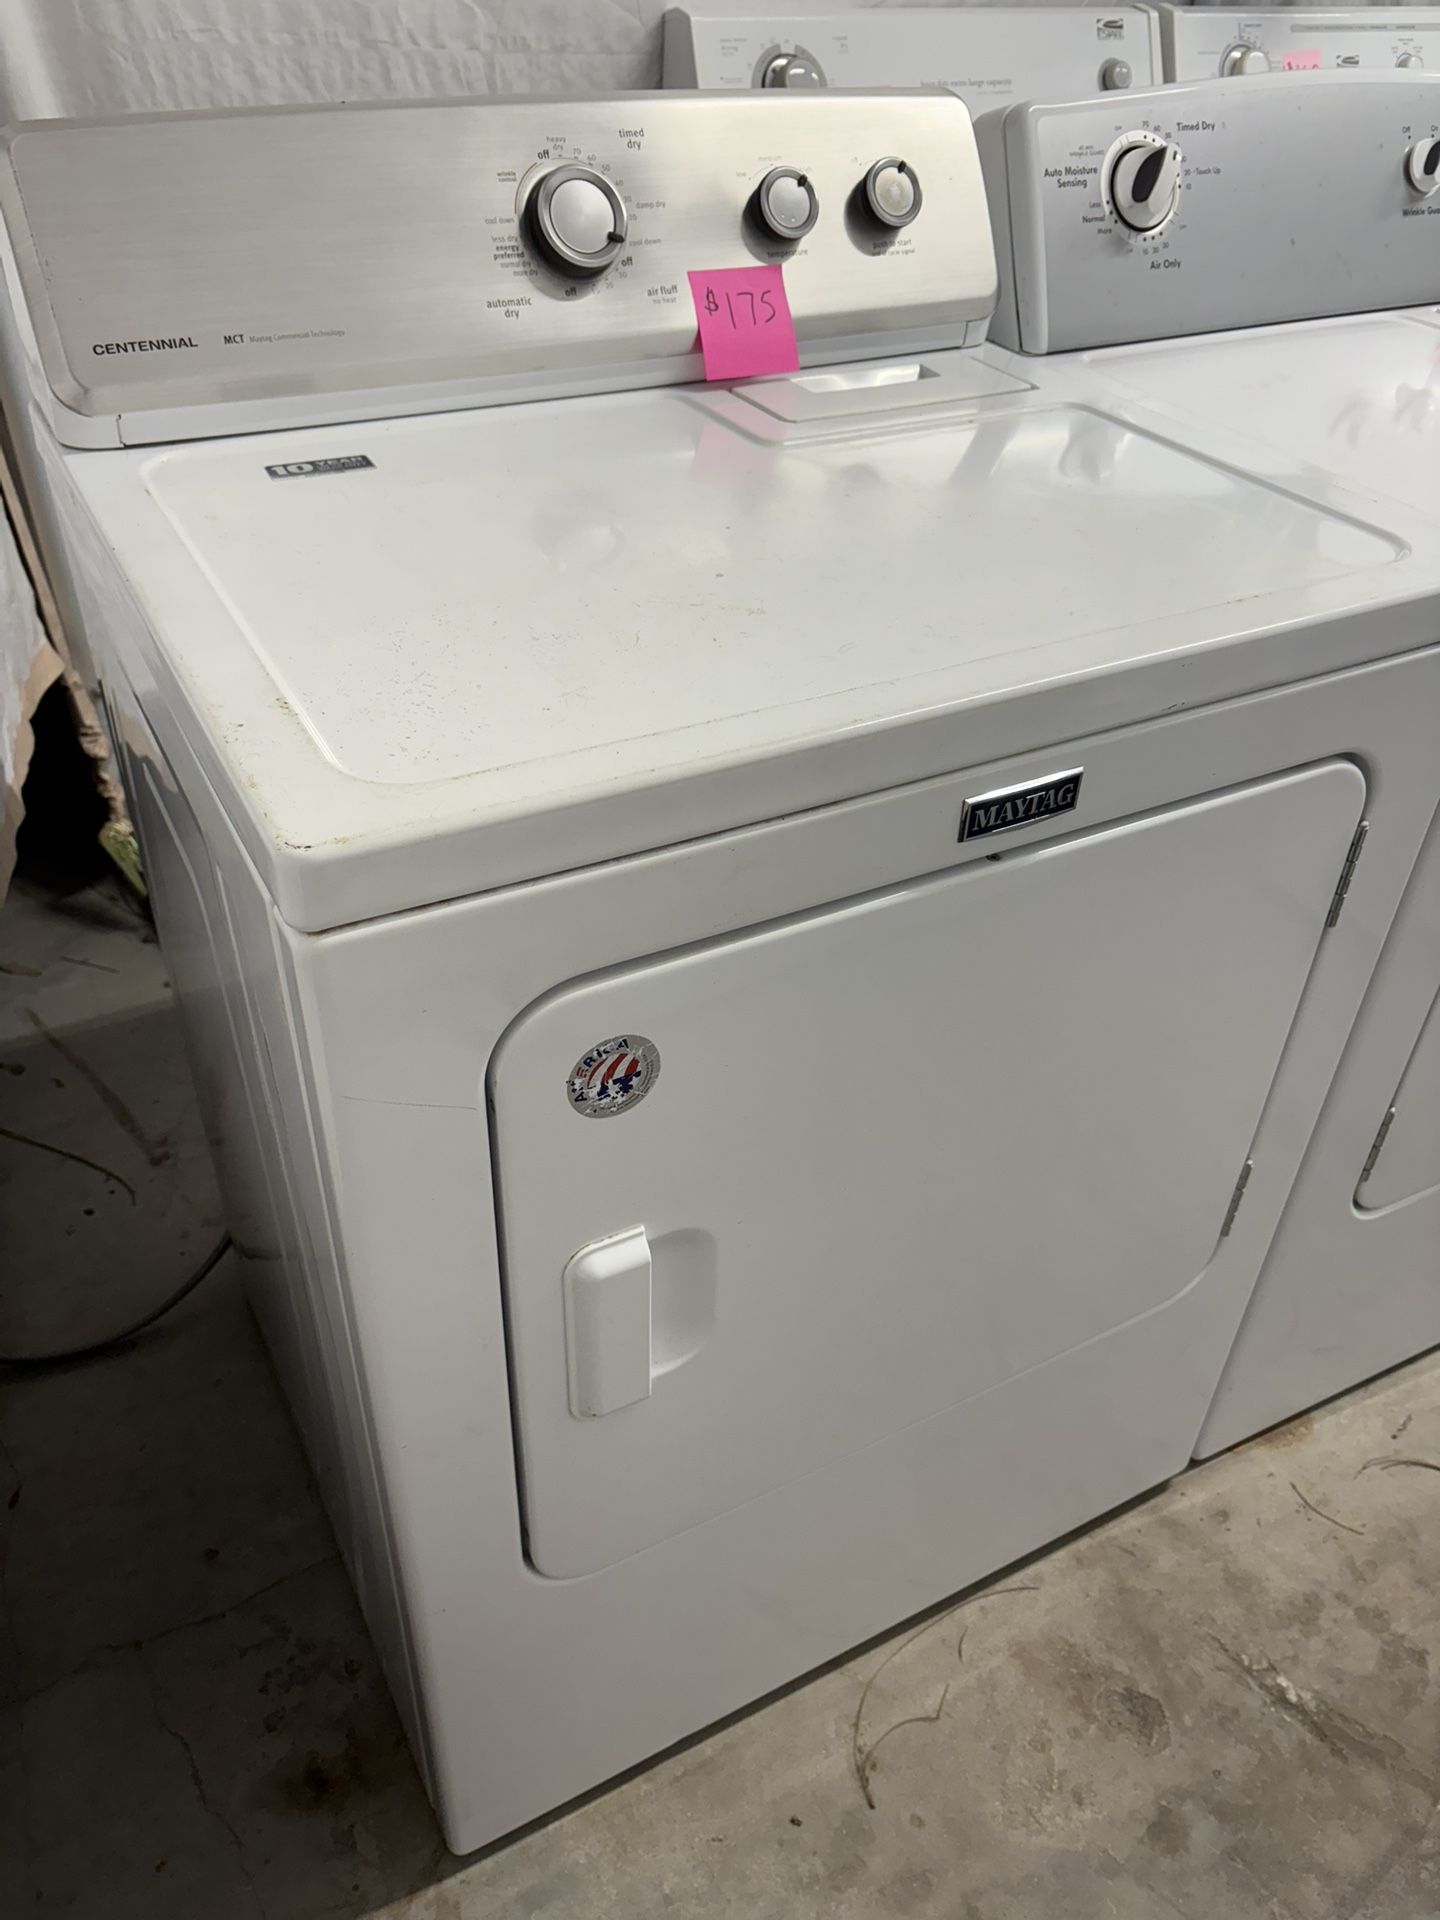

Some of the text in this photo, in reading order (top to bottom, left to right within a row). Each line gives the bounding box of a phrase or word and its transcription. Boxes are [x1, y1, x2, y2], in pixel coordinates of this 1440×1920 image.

[1176, 121, 1215, 131] Timed Dry
[618, 128, 645, 138] timed
[627, 139, 641, 151] dry
[538, 149, 550, 160] off
[1044, 166, 1098, 177] Auto Moisture
[1057, 178, 1088, 189] Sensing
[1402, 207, 1425, 216] Wrinkle
[1082, 215, 1105, 223] Normal
[493, 251, 525, 261] preferred
[767, 249, 808, 259] temperature
[621, 257, 633, 267] off
[1150, 259, 1182, 269] Air Only
[565, 287, 577, 297] off
[647, 285, 678, 297] air fluff
[486, 297, 533, 309] automatic
[704, 287, 776, 329] $175
[504, 309, 520, 319] dry
[223, 334, 245, 345] MCT
[249, 335, 273, 343] Maytag
[93, 336, 198, 356] CENTENNIAL
[271, 463, 314, 476] 10
[971, 784, 1075, 831] MAYTAG
